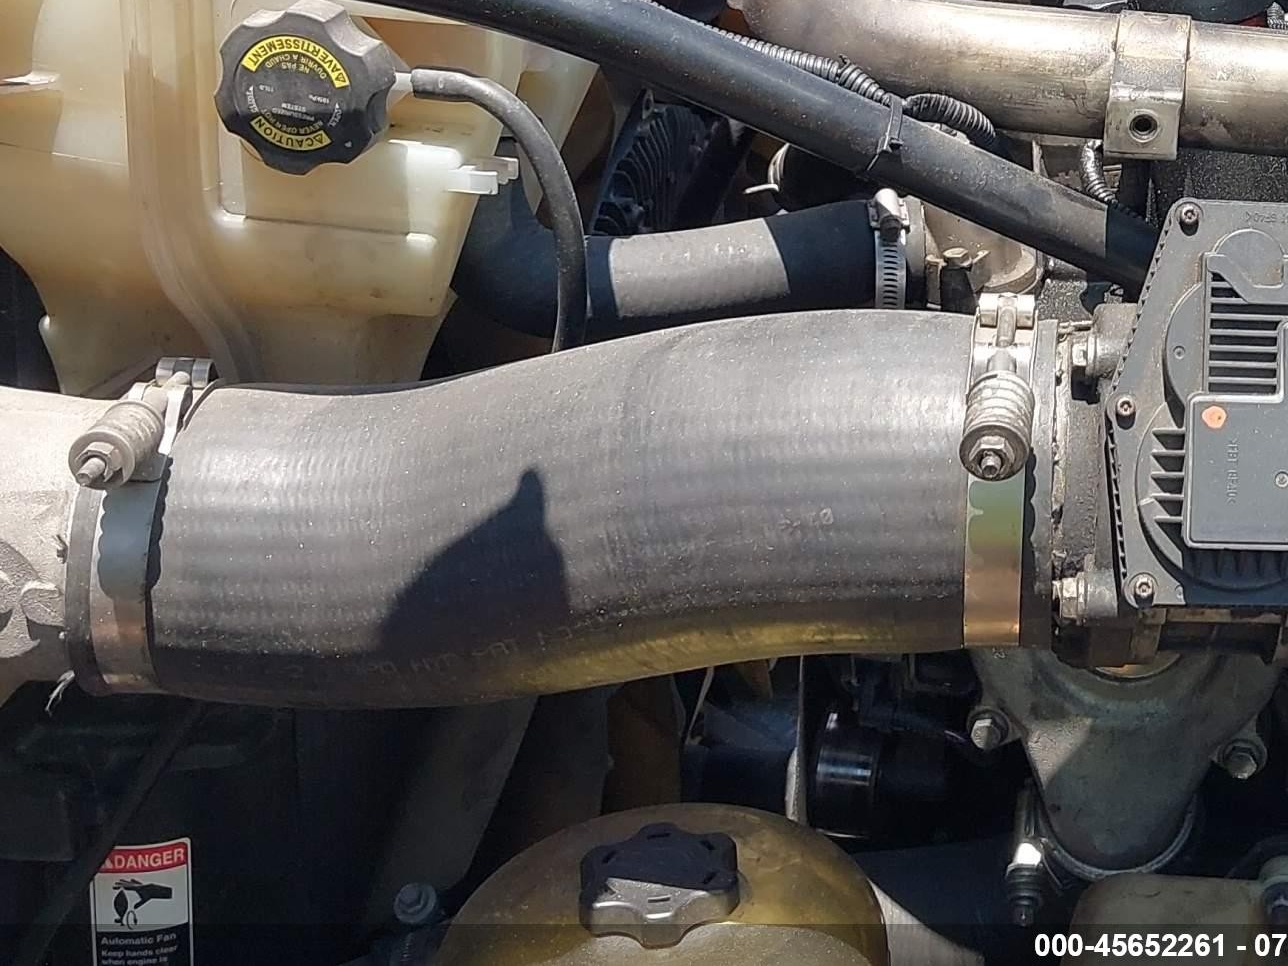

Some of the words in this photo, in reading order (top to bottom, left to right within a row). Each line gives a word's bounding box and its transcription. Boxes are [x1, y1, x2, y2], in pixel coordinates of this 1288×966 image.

[248, 38, 342, 73] AVERTISSEMENT
[265, 54, 290, 68] CHAUD
[281, 62, 297, 70] PAS
[255, 118, 314, 147] CAUTION
[114, 847, 185, 869] DANGER
[101, 936, 154, 945] Automatic
[156, 933, 177, 943] Fan
[101, 949, 124, 958] Keep
[125, 948, 153, 957] hands
[102, 957, 125, 965] when
[127, 956, 157, 966] engine
